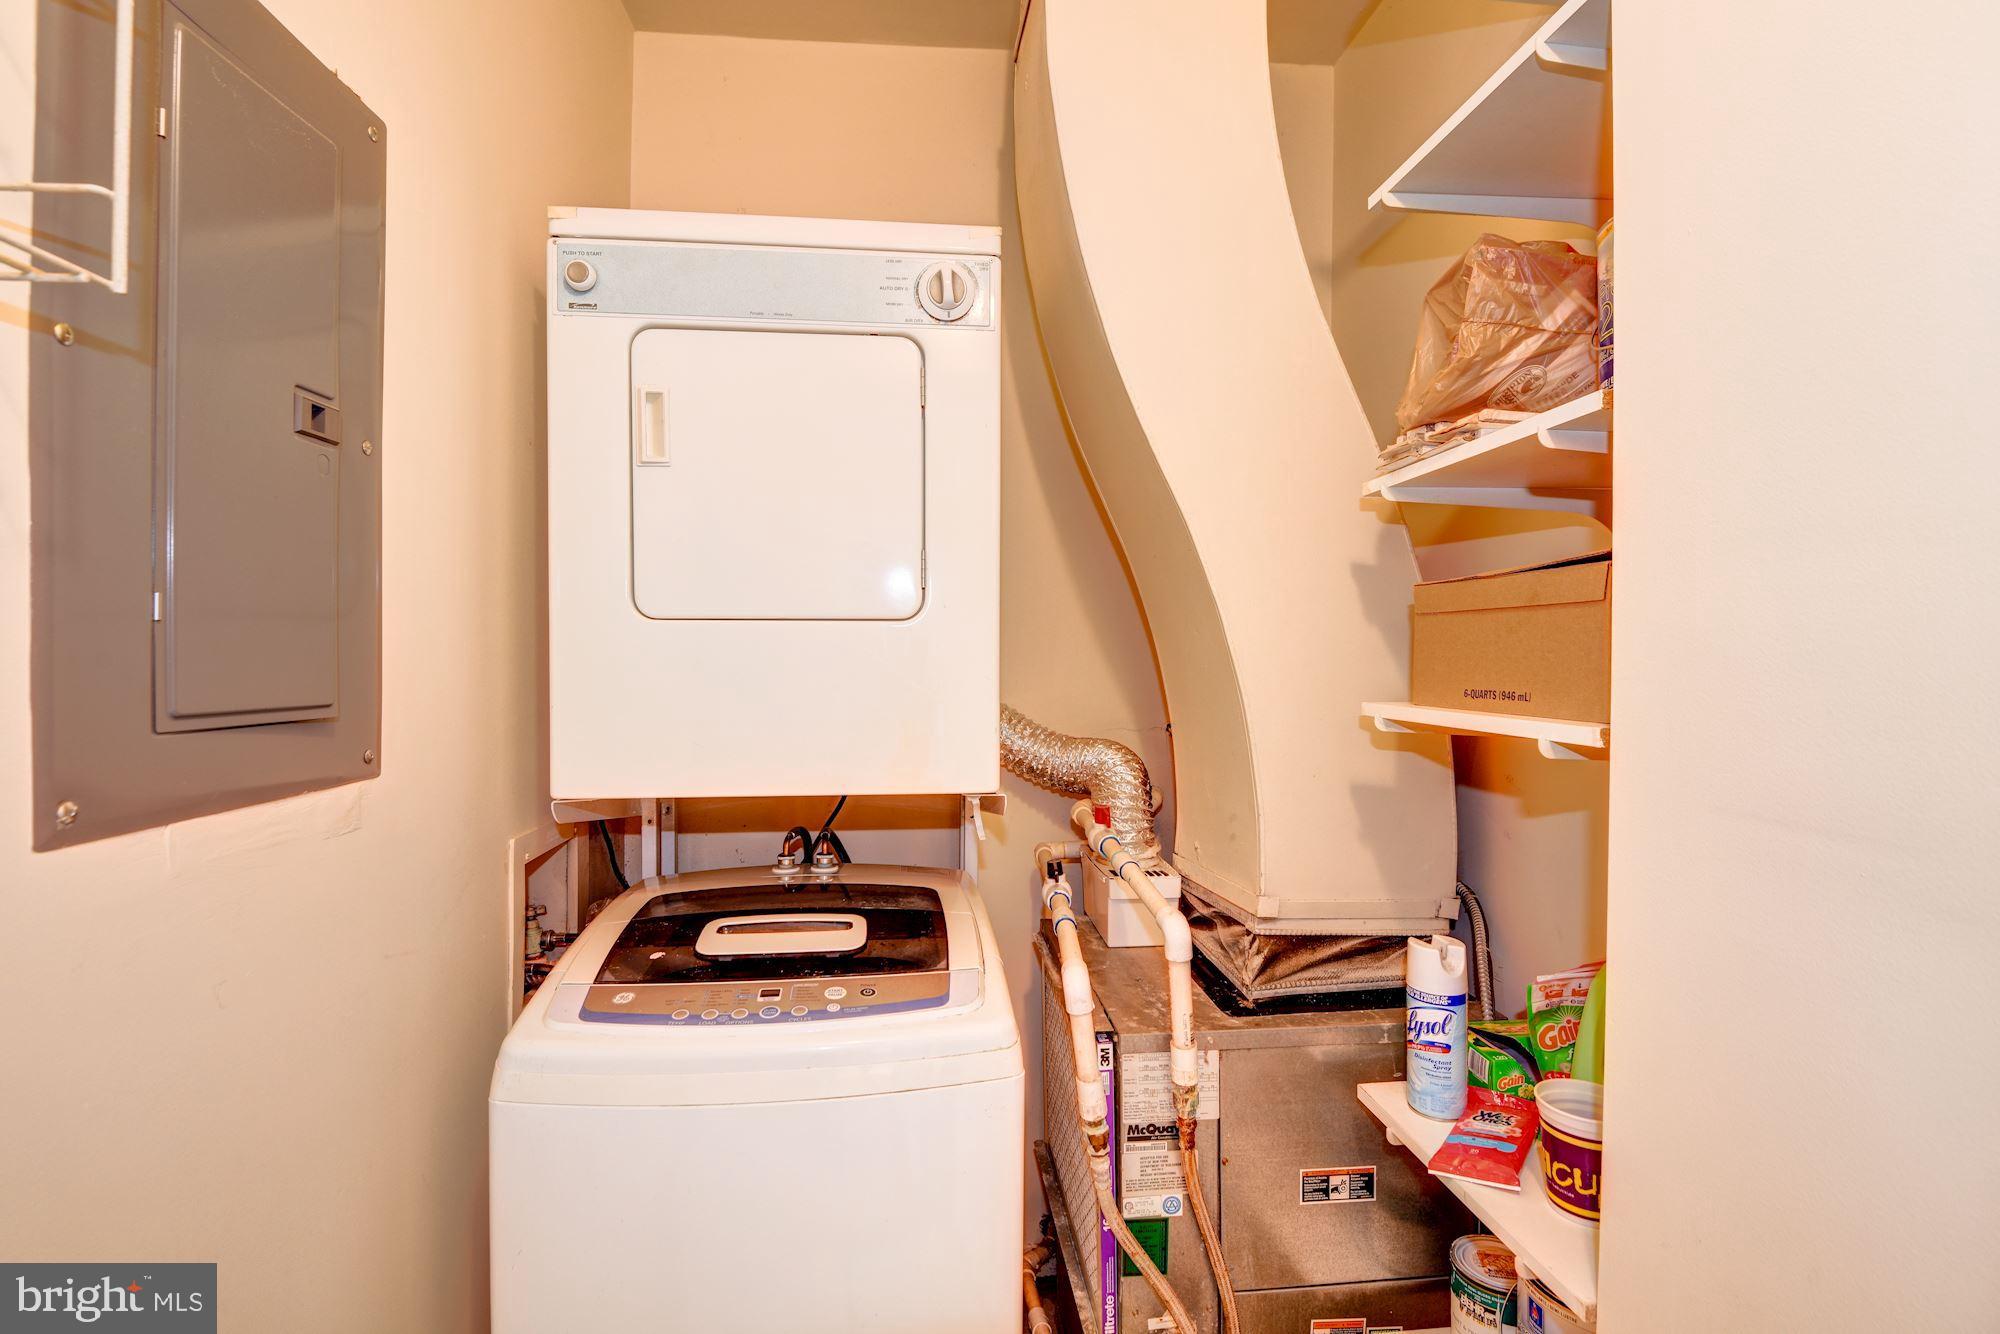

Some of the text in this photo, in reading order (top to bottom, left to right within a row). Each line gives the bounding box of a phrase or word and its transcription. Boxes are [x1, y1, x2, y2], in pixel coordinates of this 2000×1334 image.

[1464, 688, 1532, 703] 6-QUARTS (946 mL)
[1408, 1010, 1453, 1042] Lysol
[1100, 1047, 1110, 1067] 3M
[1414, 1052, 1452, 1066] Disinfectant
[1497, 1073, 1525, 1091] Gain
[1472, 1114, 1513, 1126] Ones
[1480, 1110, 1516, 1121] Wet
[1104, 1295, 1115, 1334] iltrete
